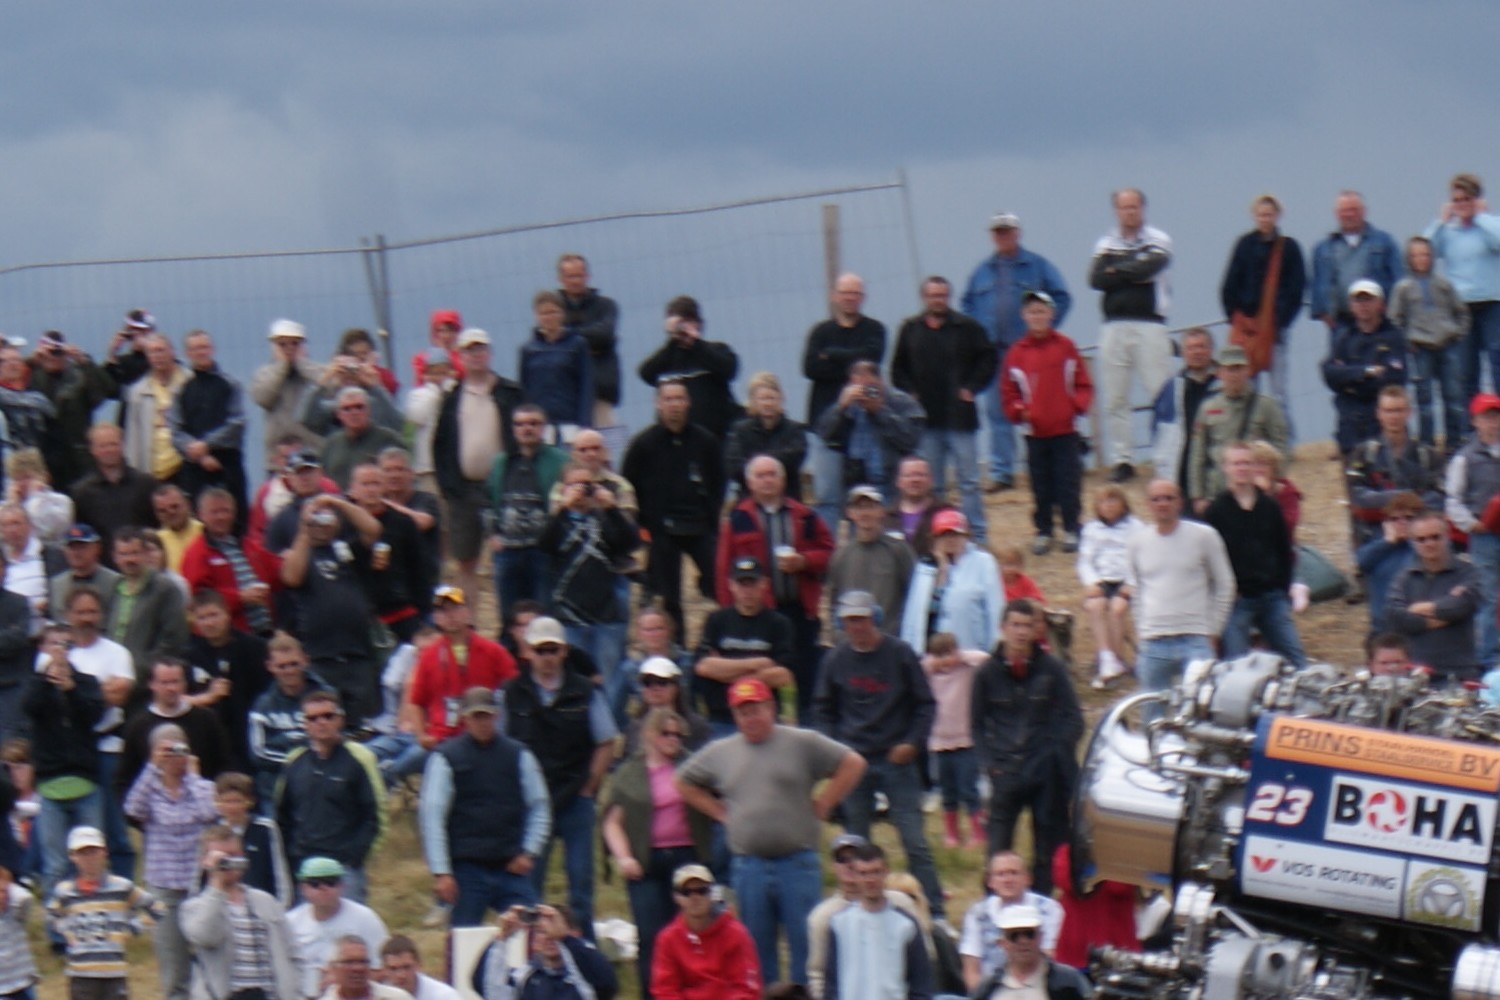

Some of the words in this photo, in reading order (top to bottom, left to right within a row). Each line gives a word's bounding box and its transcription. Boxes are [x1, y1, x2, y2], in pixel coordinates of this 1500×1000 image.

[1276, 725, 1364, 756] PRINS
[1459, 753, 1499, 776] BV
[1246, 784, 1313, 826] 23
